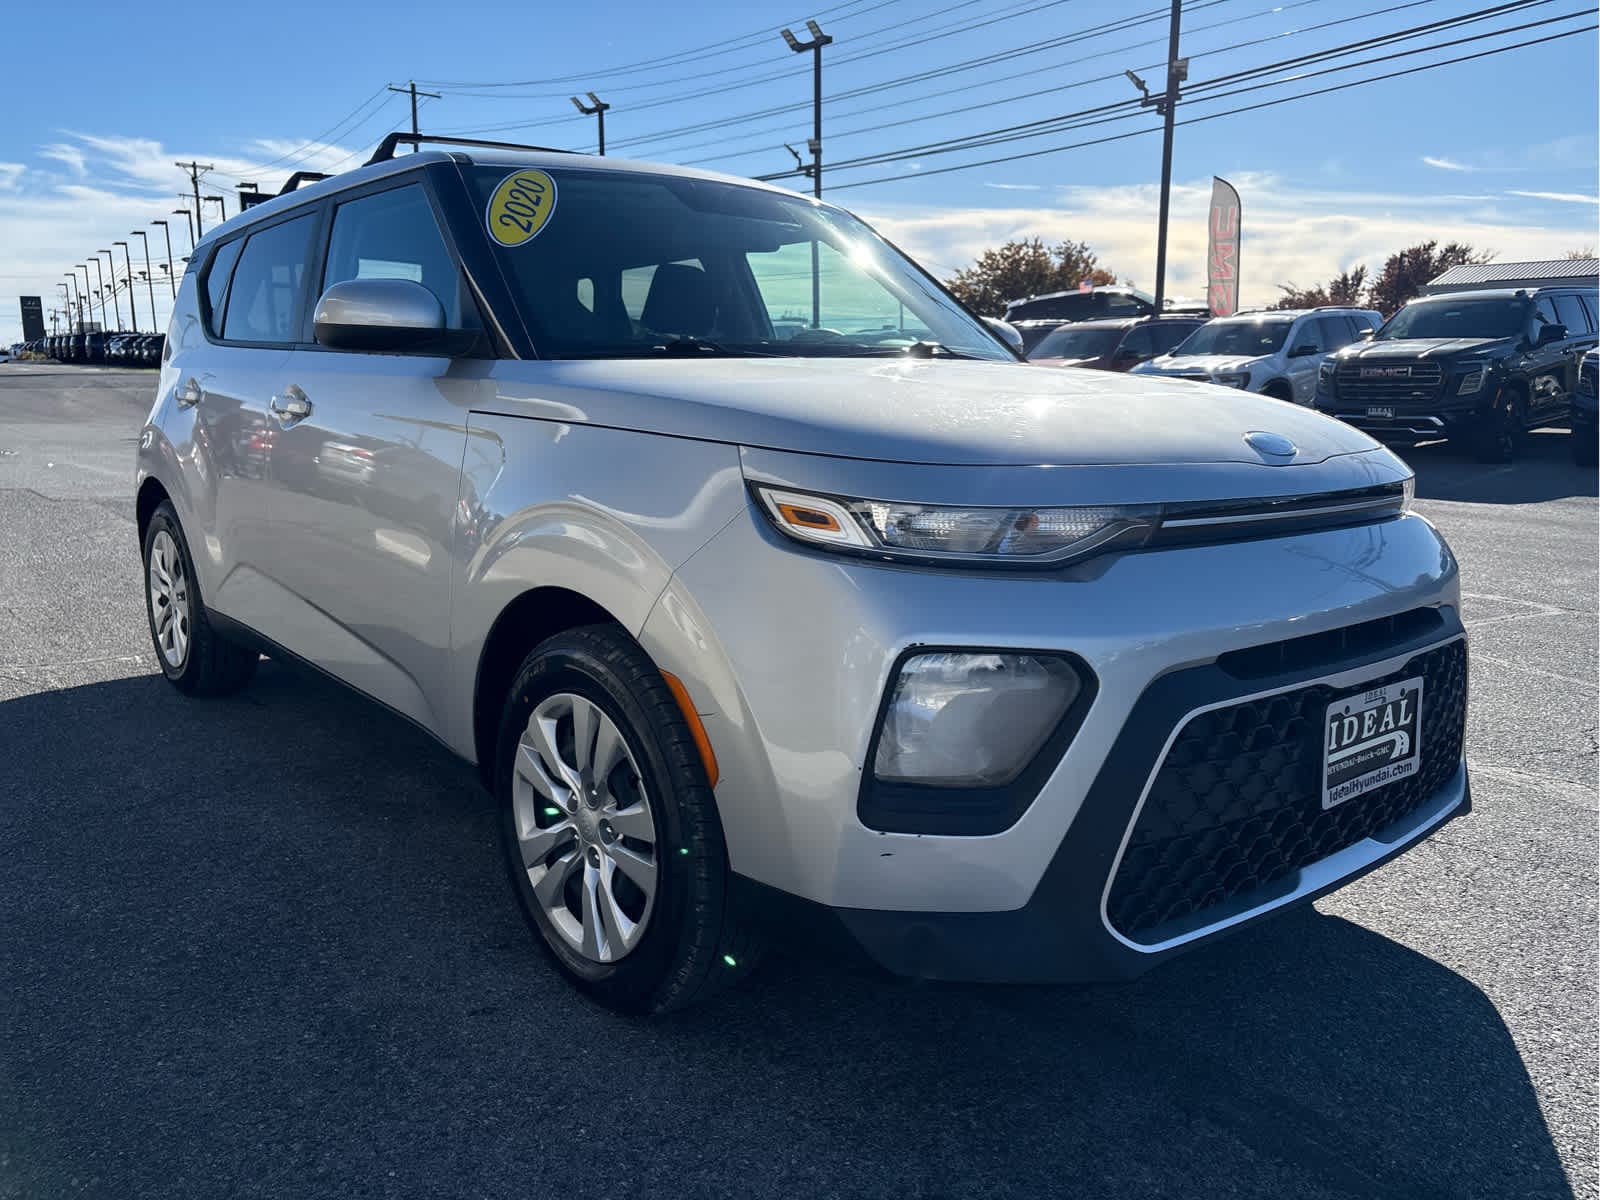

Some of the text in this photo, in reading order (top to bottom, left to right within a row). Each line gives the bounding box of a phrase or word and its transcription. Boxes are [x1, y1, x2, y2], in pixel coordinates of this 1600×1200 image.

[499, 178, 545, 233] 2020
[1329, 699, 1412, 750] IDEAL
[1329, 761, 1412, 803] IdealHyundai.com
